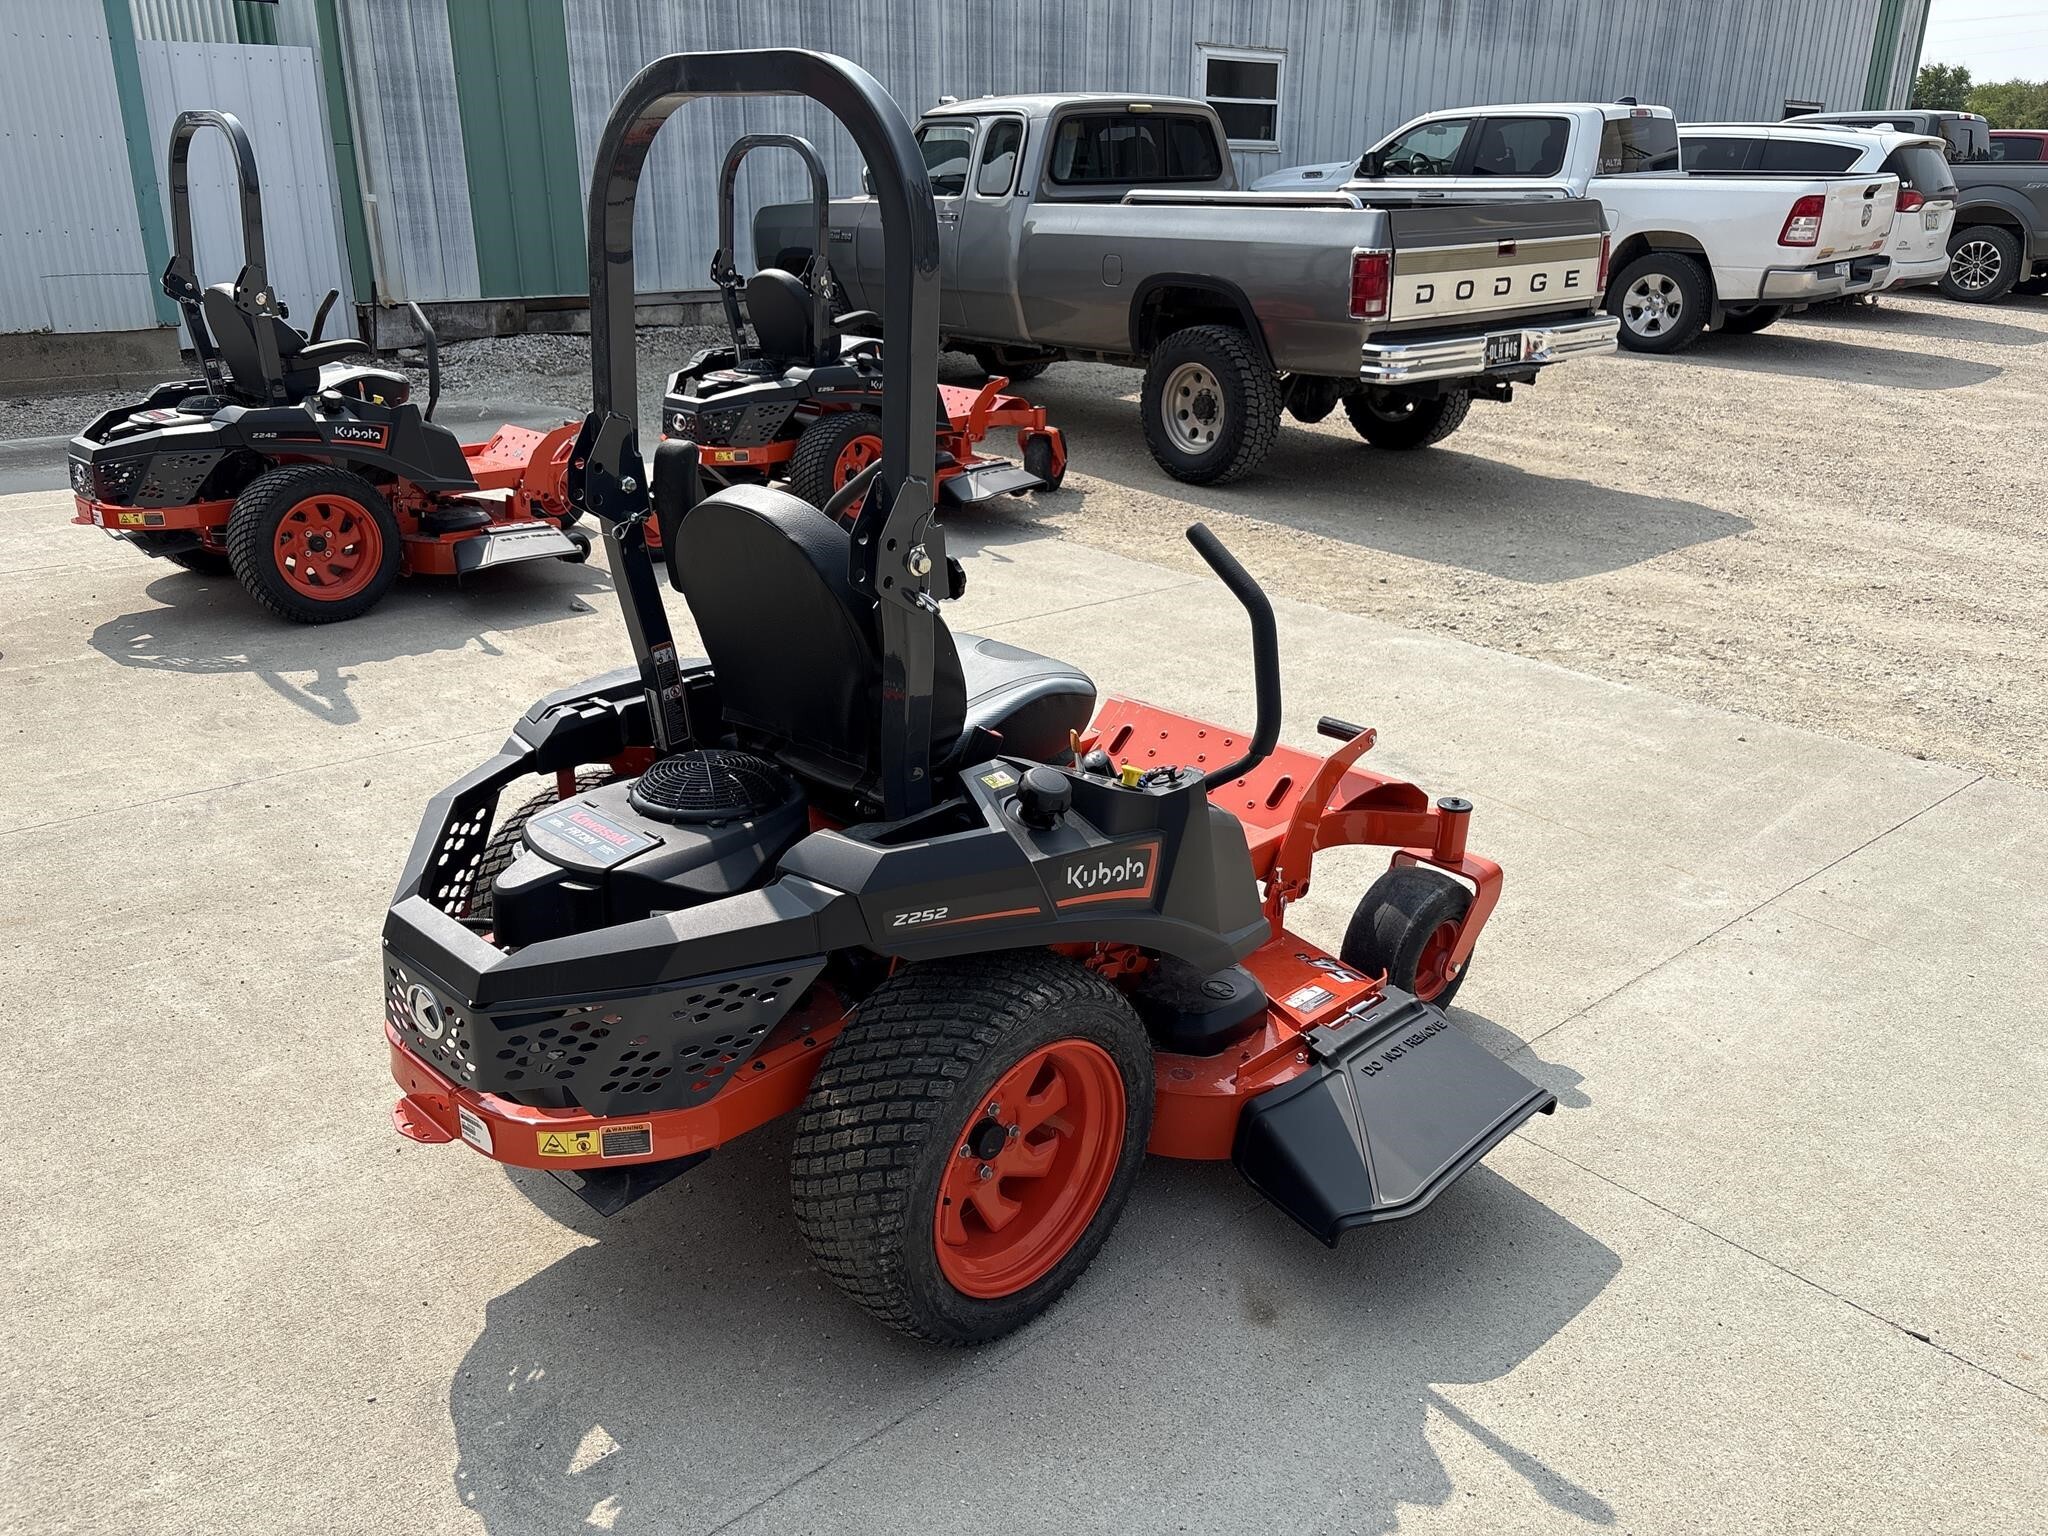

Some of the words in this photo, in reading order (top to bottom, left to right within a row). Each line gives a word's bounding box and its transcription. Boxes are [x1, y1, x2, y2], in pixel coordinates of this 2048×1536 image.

[1415, 269, 1580, 304] DODGE
[334, 426, 381, 439] Kubota
[567, 811, 635, 847] Kawasaki
[1066, 856, 1145, 889] Kubota
[892, 906, 949, 927] Z252
[1360, 1060, 1384, 1078] DO
[1380, 1044, 1408, 1063] NOT
[1402, 1020, 1449, 1049] REMOVE
